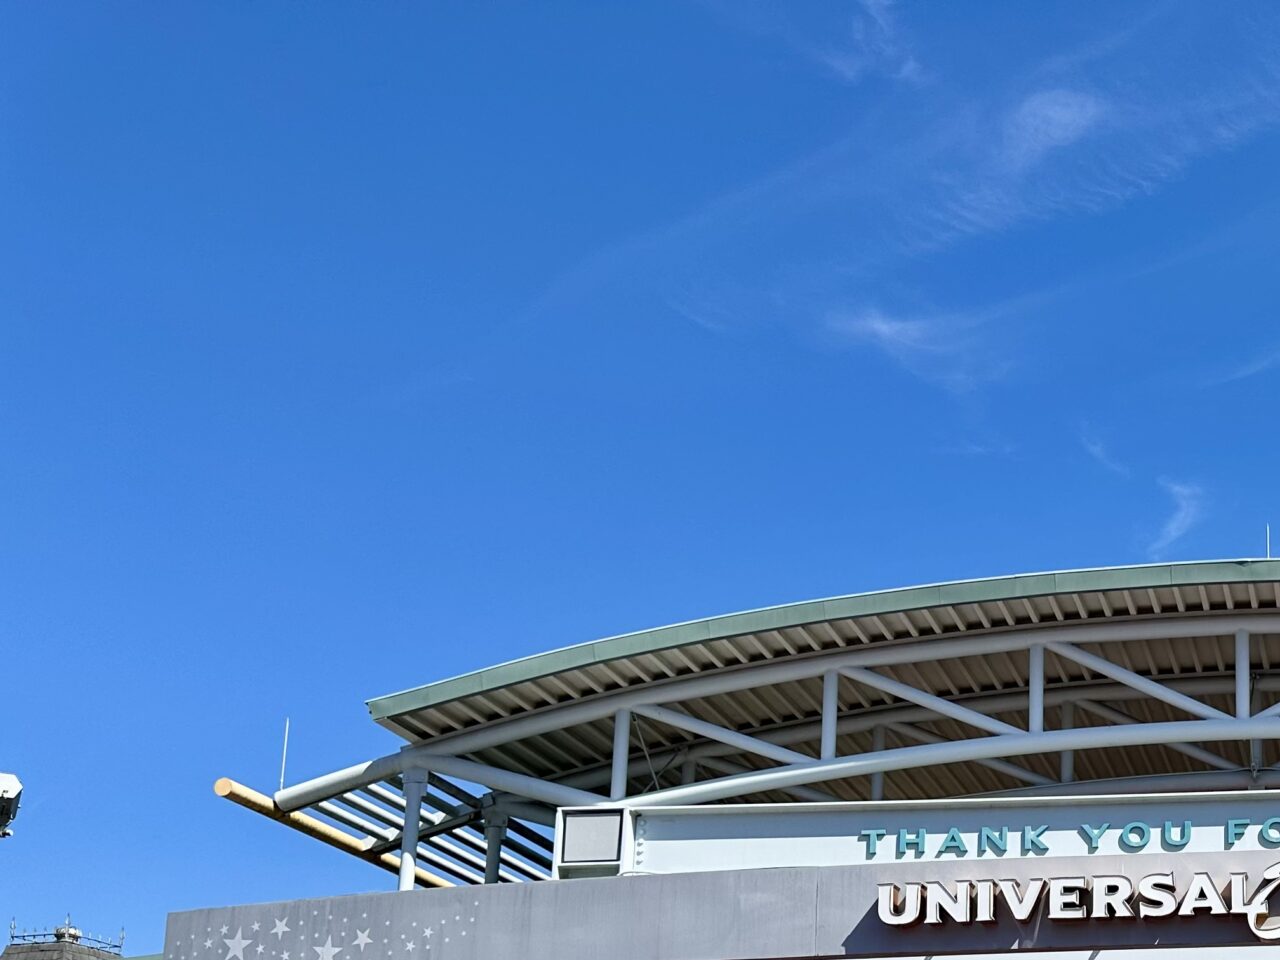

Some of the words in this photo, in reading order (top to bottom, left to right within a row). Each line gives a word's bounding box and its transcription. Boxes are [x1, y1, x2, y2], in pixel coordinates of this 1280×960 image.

[861, 825, 1049, 859] THANK
[1081, 821, 1192, 853] YOU
[877, 871, 1268, 926] UNIVERSAL
